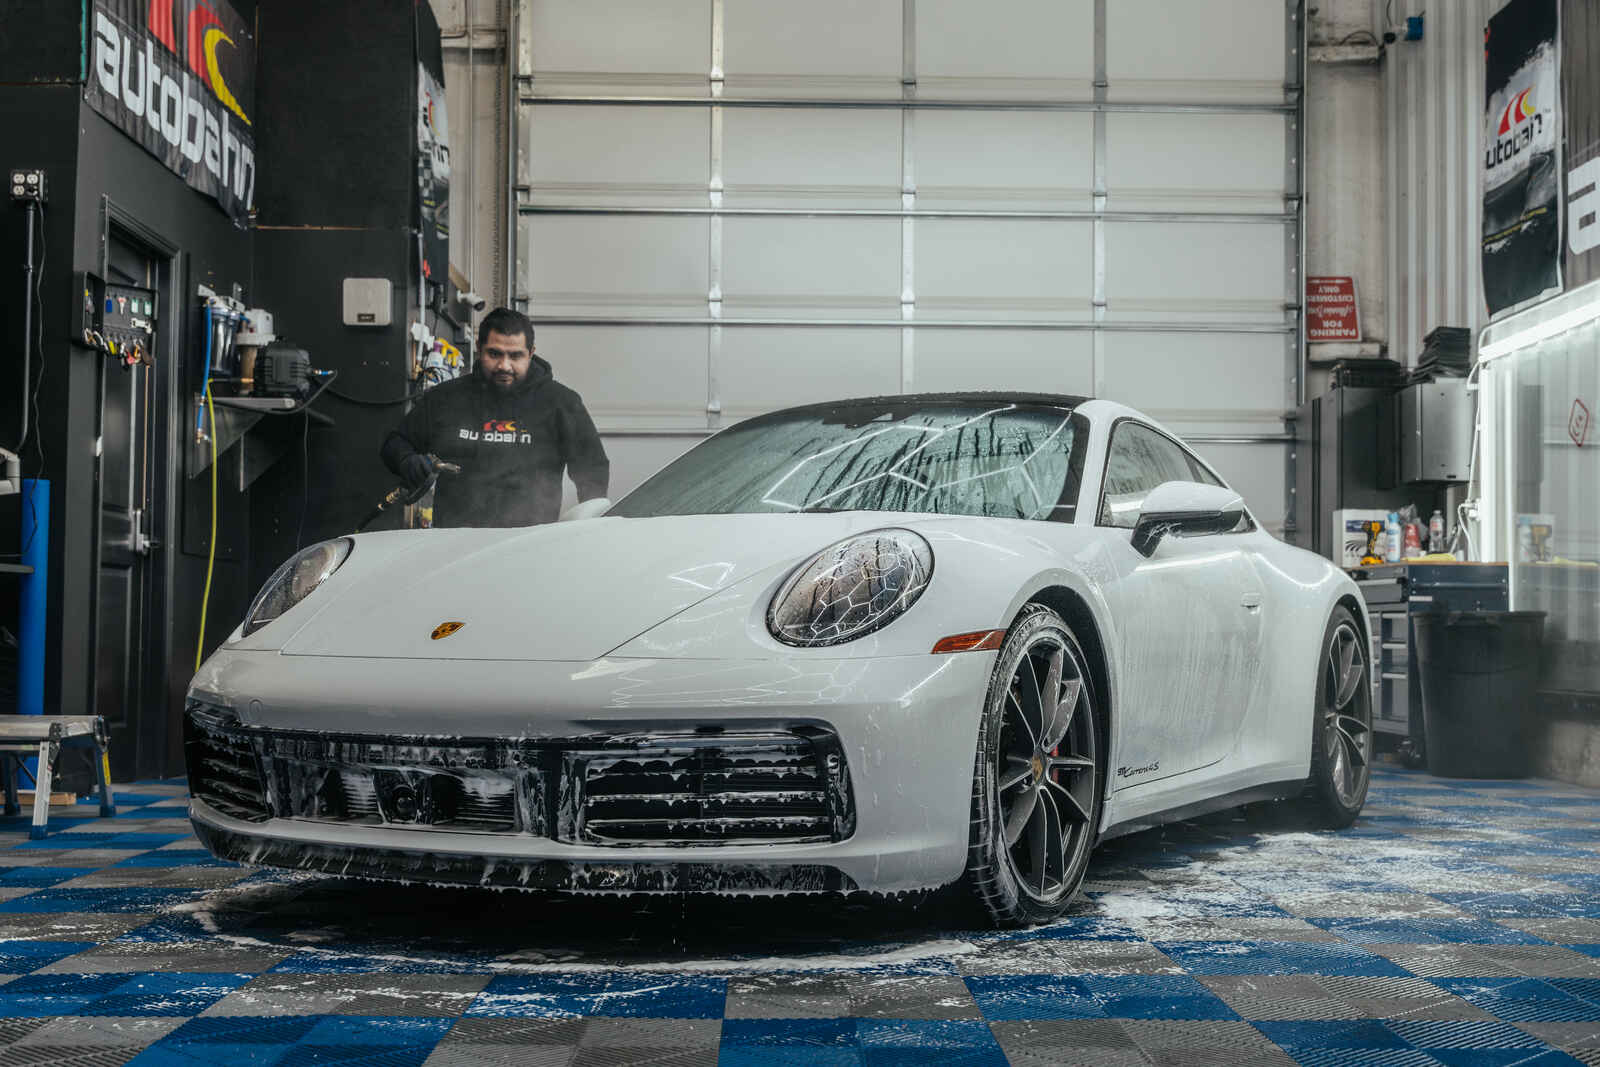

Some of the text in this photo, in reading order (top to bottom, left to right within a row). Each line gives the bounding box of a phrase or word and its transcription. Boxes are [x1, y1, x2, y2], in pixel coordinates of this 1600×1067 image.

[96, 11, 255, 211] autobahn
[1322, 320, 1343, 328] FOR
[1310, 328, 1356, 337] PARKING
